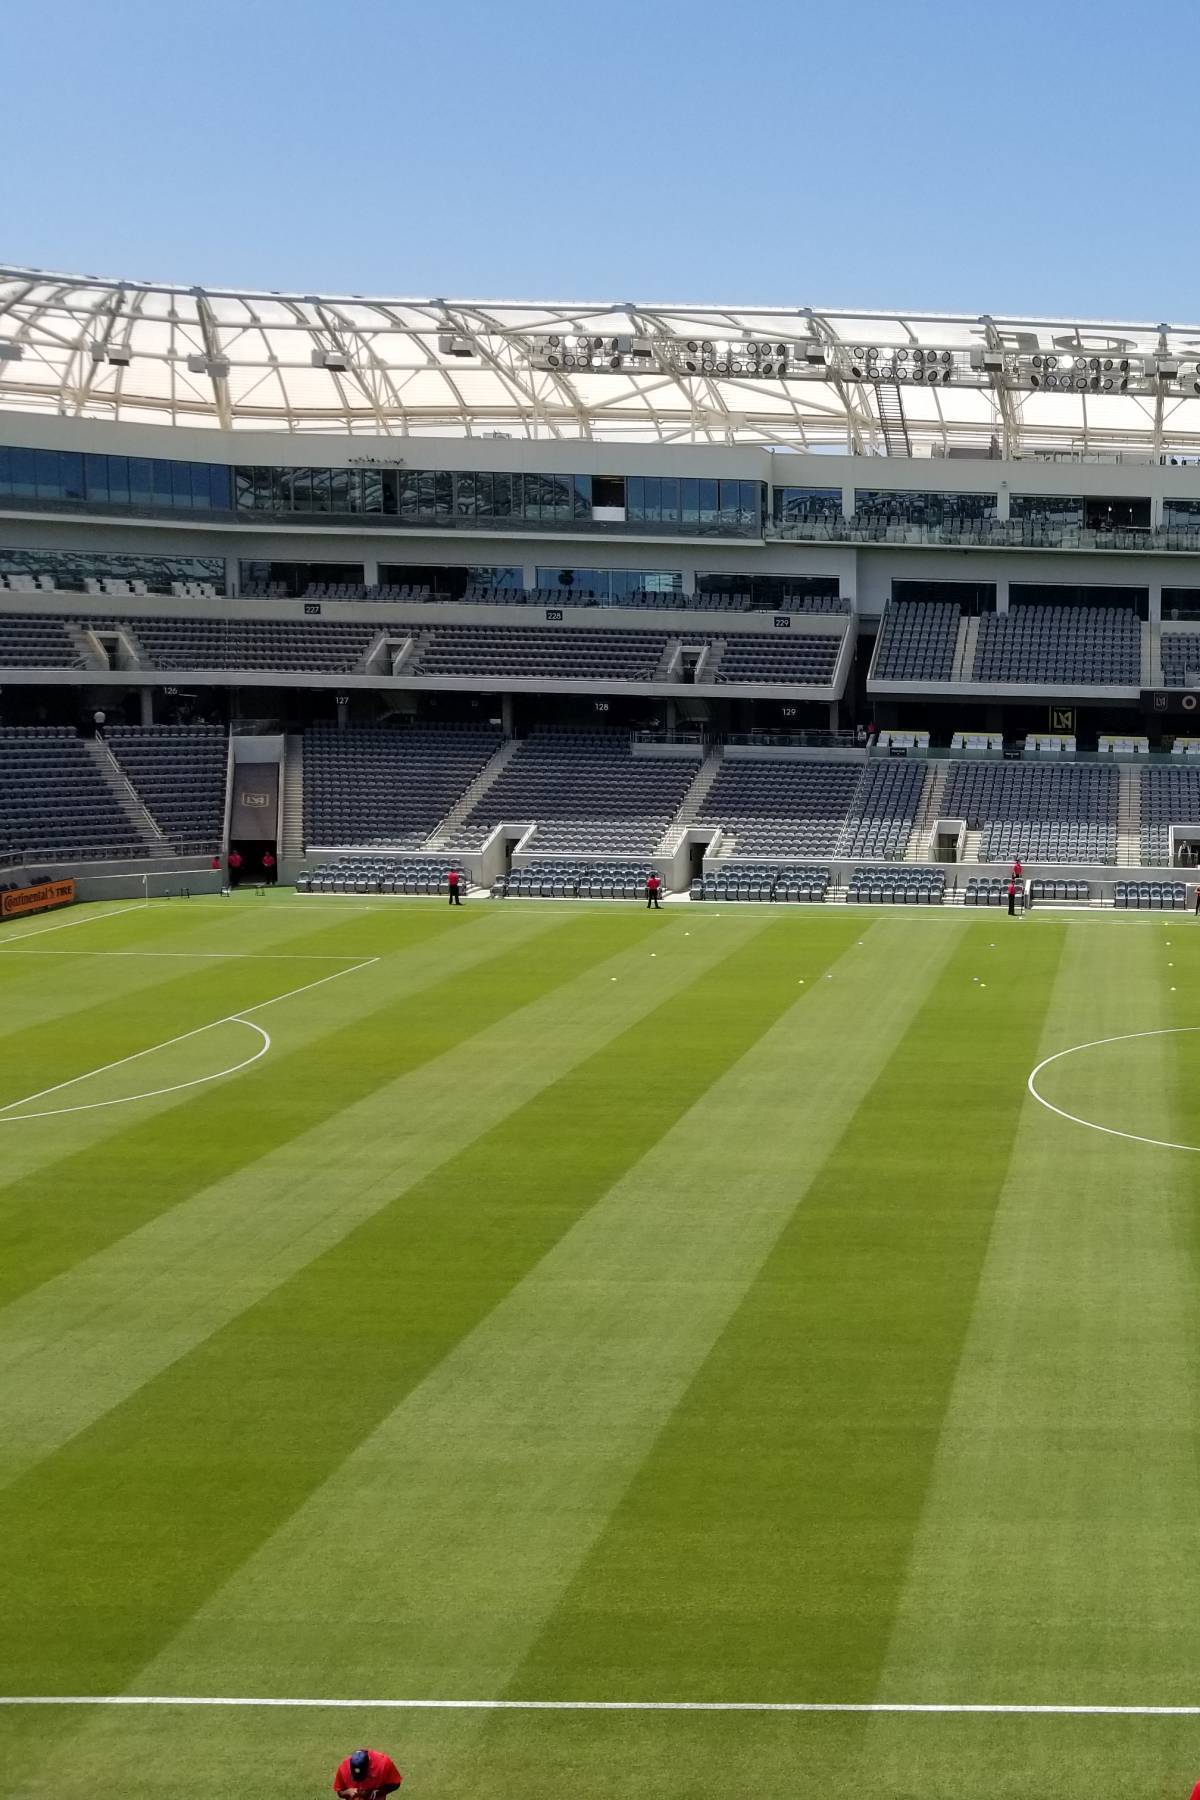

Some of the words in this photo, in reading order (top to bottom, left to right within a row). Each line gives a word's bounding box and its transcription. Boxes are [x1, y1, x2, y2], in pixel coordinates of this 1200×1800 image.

[305, 605, 320, 614] 227
[547, 611, 562, 620] 228
[775, 618, 790, 627] 229
[164, 687, 178, 695] 126
[335, 696, 349, 705] 127
[595, 703, 609, 711] 128
[783, 708, 797, 716] 129
[4, 887, 48, 911] Continental
[56, 885, 73, 897] TIRE
